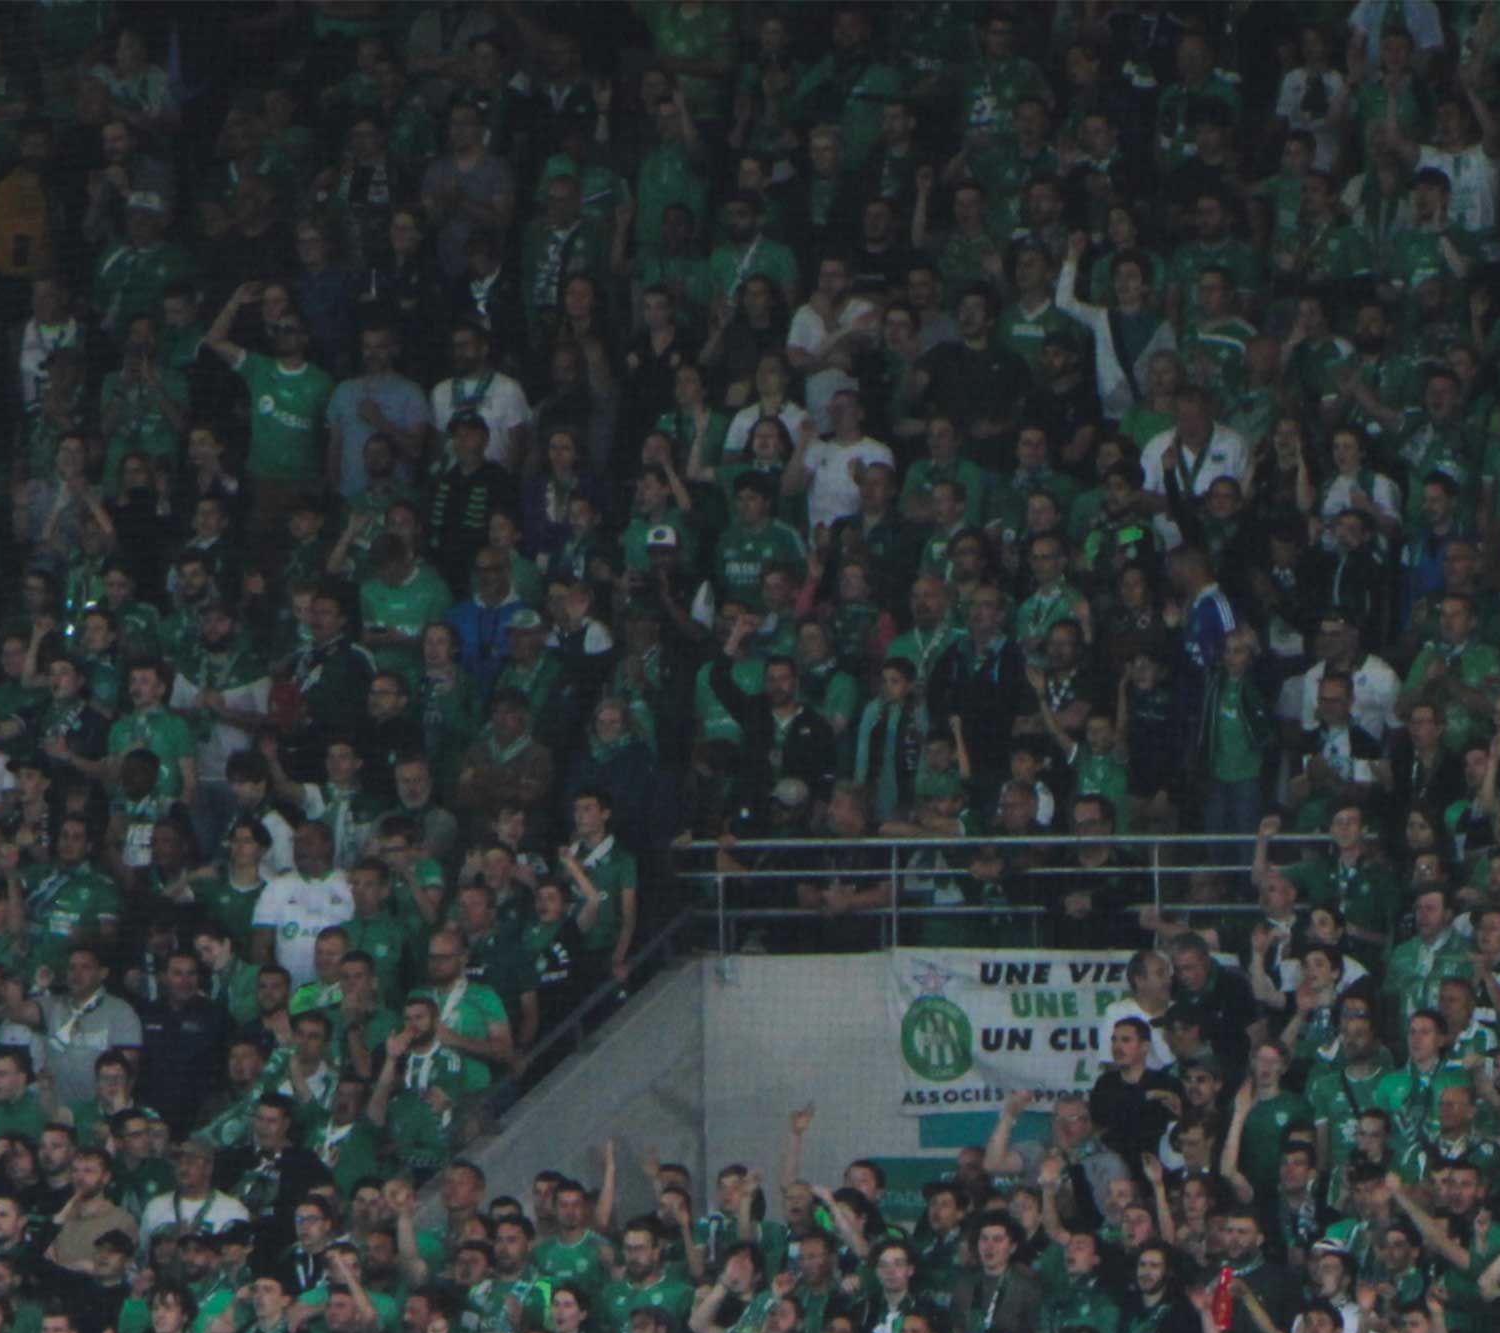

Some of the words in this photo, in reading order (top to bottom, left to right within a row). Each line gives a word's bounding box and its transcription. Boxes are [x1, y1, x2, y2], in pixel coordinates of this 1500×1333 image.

[980, 962, 1052, 985] UNE
[1011, 991, 1079, 1018] UNE
[982, 1028, 1033, 1051] UN
